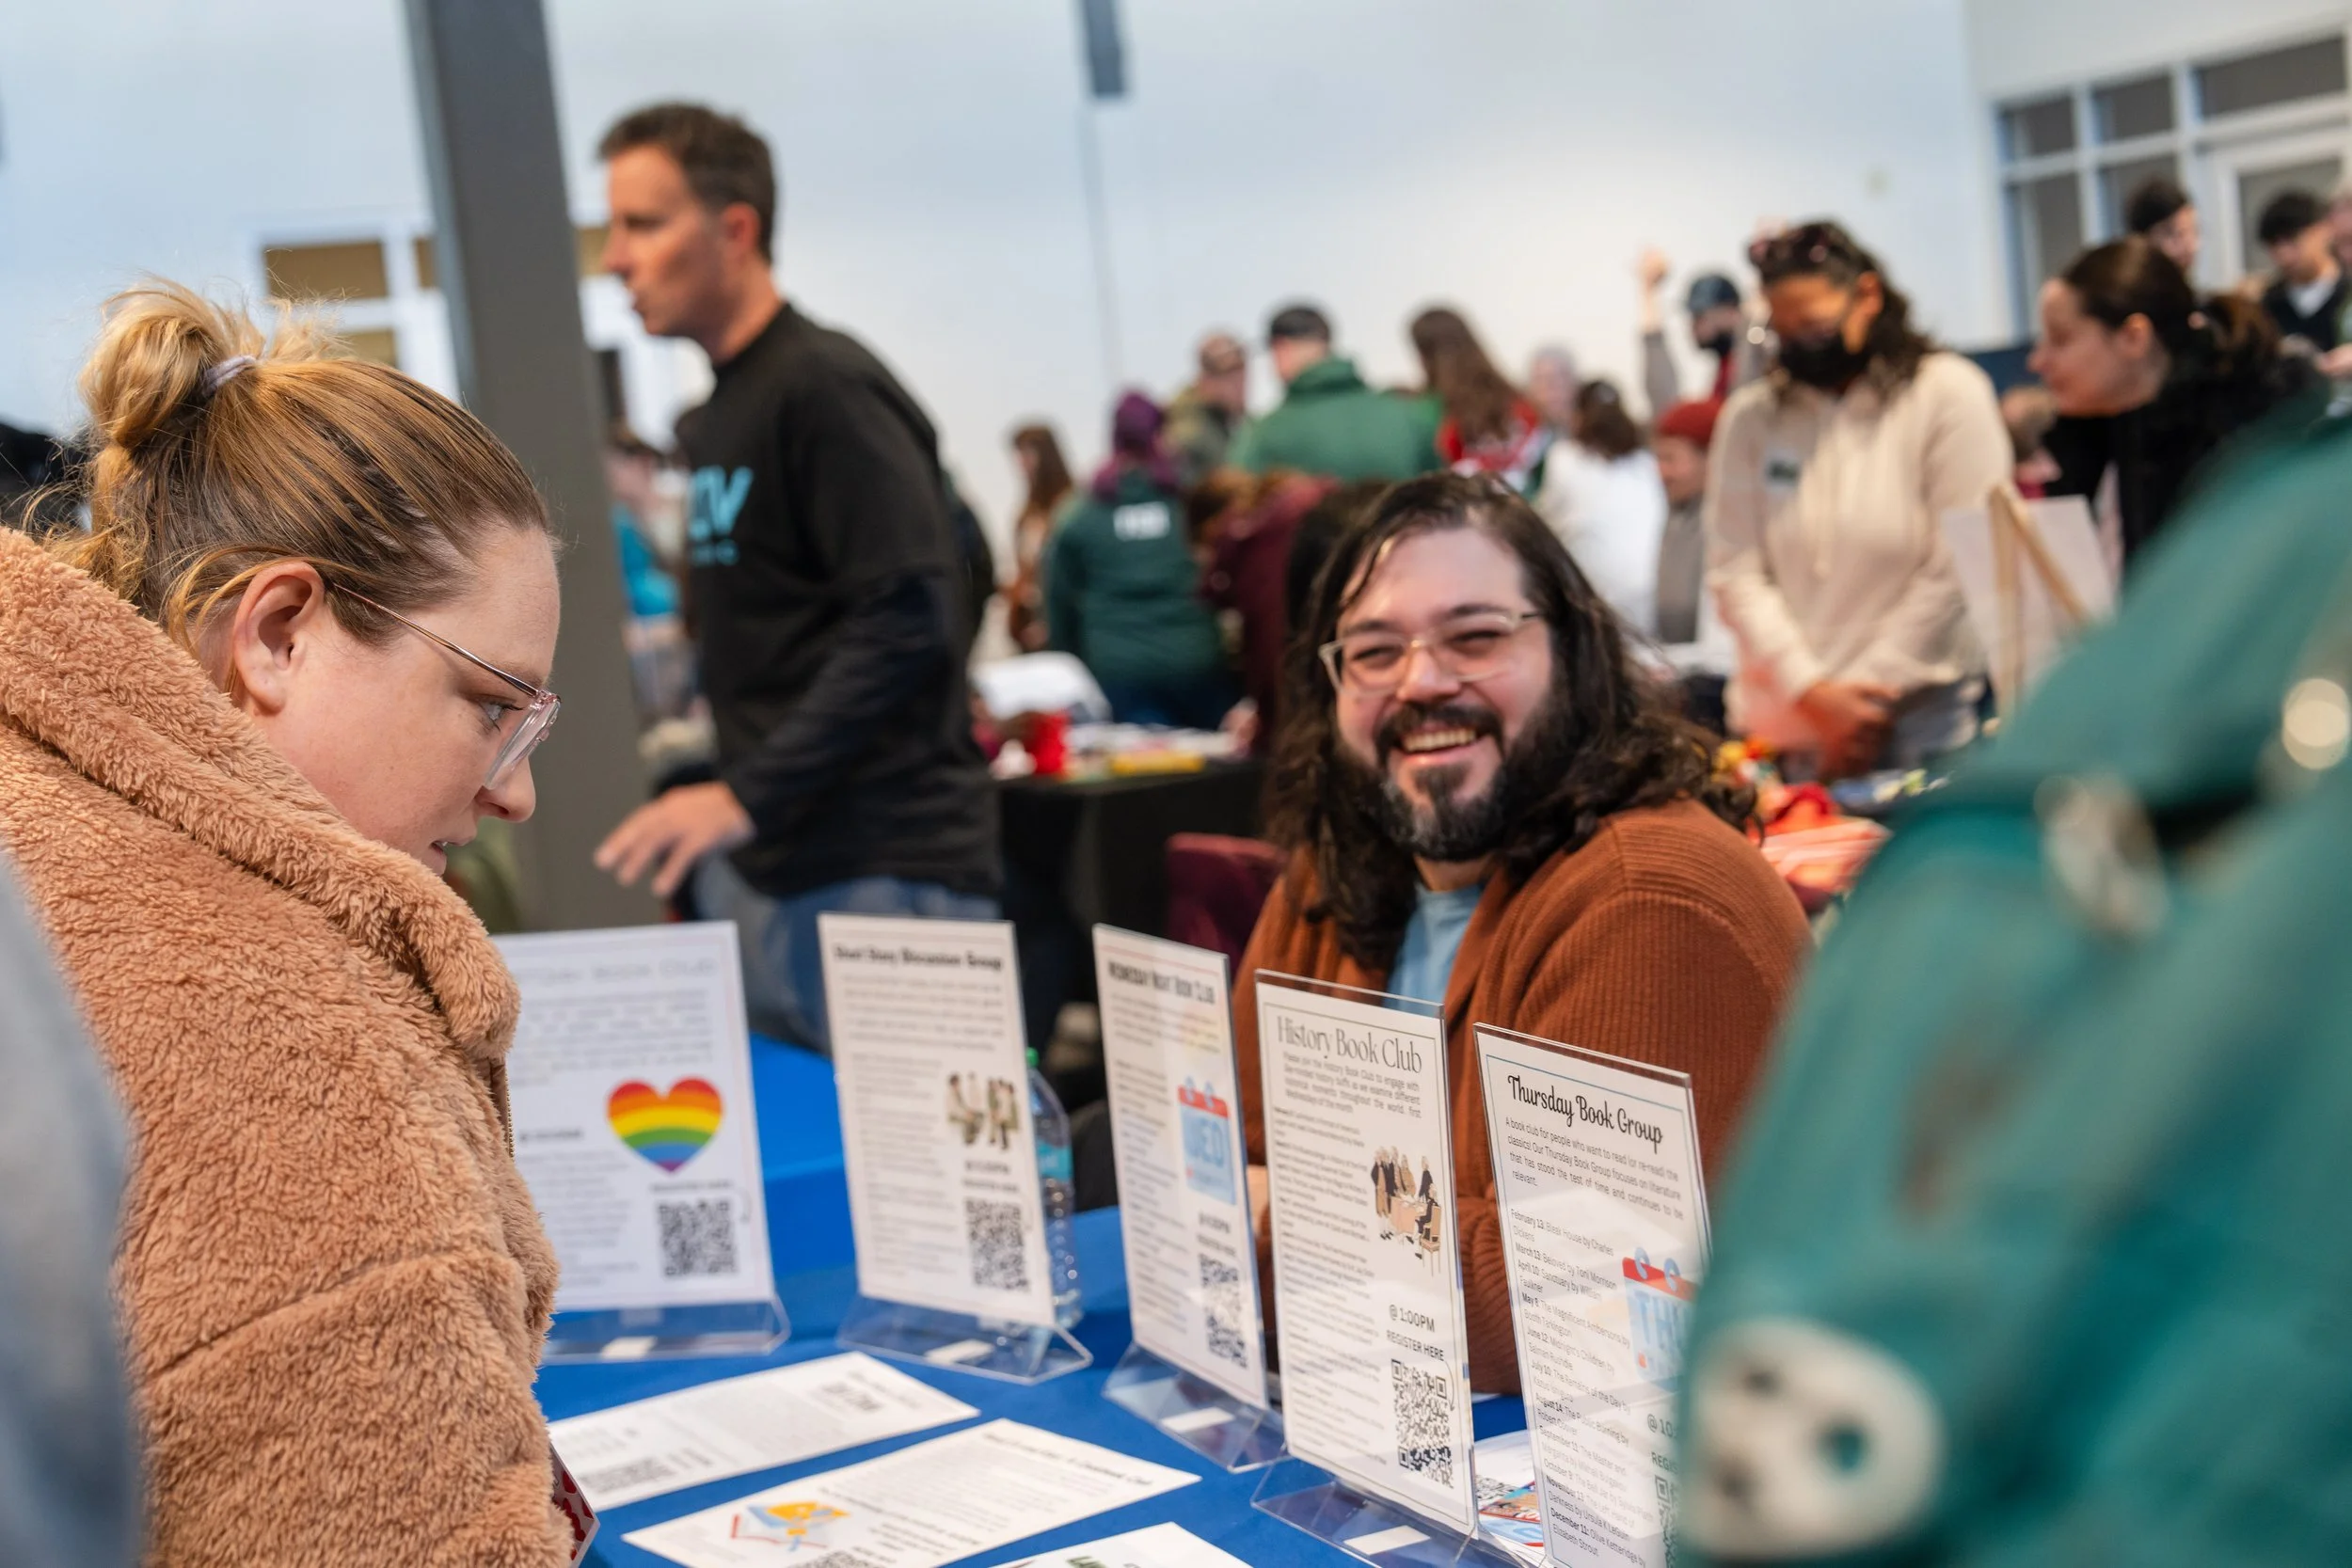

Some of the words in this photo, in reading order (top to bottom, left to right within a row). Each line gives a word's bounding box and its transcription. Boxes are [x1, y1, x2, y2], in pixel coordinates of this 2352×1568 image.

[1277, 1016, 1331, 1059] History
[1335, 1028, 1379, 1064] Book
[1381, 1037, 1422, 1073] Club
[1360, 1069, 1375, 1082] Club
[1507, 1075, 1574, 1128] Thursday
[1575, 1095, 1614, 1130] Book
[1616, 1108, 1663, 1154] Group
[1510, 1117, 1525, 1132] book
[1525, 1125, 1539, 1137] club
[1539, 1127, 1549, 1139] for
[1549, 1132, 1571, 1148] people
[1571, 1140, 1585, 1152] who
[1586, 1146, 1603, 1158] want
[1602, 1148, 1612, 1160] to
[1612, 1152, 1628, 1165] read
[1666, 1169, 1679, 1182] the
[1507, 1135, 1532, 1151] classics!
[1532, 1142, 1544, 1155] Our
[1544, 1145, 1573, 1167] Thursday
[1573, 1155, 1590, 1170] Book
[1590, 1161, 1612, 1178] Group
[1612, 1167, 1638, 1186] focuses
[1639, 1179, 1648, 1189] on
[1649, 1181, 1681, 1200] literature
[1509, 1151, 1523, 1164] that
[1523, 1155, 1535, 1169] has
[1536, 1162, 1555, 1176] stood
[1557, 1168, 1568, 1180] the
[1569, 1173, 1583, 1186] test
[1585, 1177, 1593, 1188] of
[1594, 1181, 1610, 1195] time
[1612, 1188, 1626, 1200] and
[1628, 1194, 1661, 1212] continues
[1662, 1204, 1672, 1216] to
[1674, 1209, 1684, 1221] be
[1510, 1208, 1536, 1229] February
[1582, 1236, 1591, 1250] by
[1591, 1238, 1614, 1257] Charles
[1515, 1242, 1534, 1258] March
[1566, 1264, 1575, 1277] by
[1576, 1265, 1590, 1280] Toni
[1590, 1271, 1617, 1290] Morrison
[1518, 1259, 1532, 1273] April
[1570, 1280, 1580, 1295] by
[1521, 1291, 1534, 1307] May
[1389, 1304, 1398, 1322] @
[1399, 1307, 1435, 1332] 1:00PM
[1527, 1328, 1541, 1340] June
[1386, 1329, 1422, 1353] REGISTER
[1423, 1343, 1444, 1362] HERE
[1609, 1394, 1622, 1408] Day
[1647, 1413, 1658, 1433] @
[1546, 1475, 1576, 1497] November
[1550, 1507, 1580, 1530] December
[1589, 1528, 1606, 1545] Olive
[1574, 1504, 1582, 1519] by
